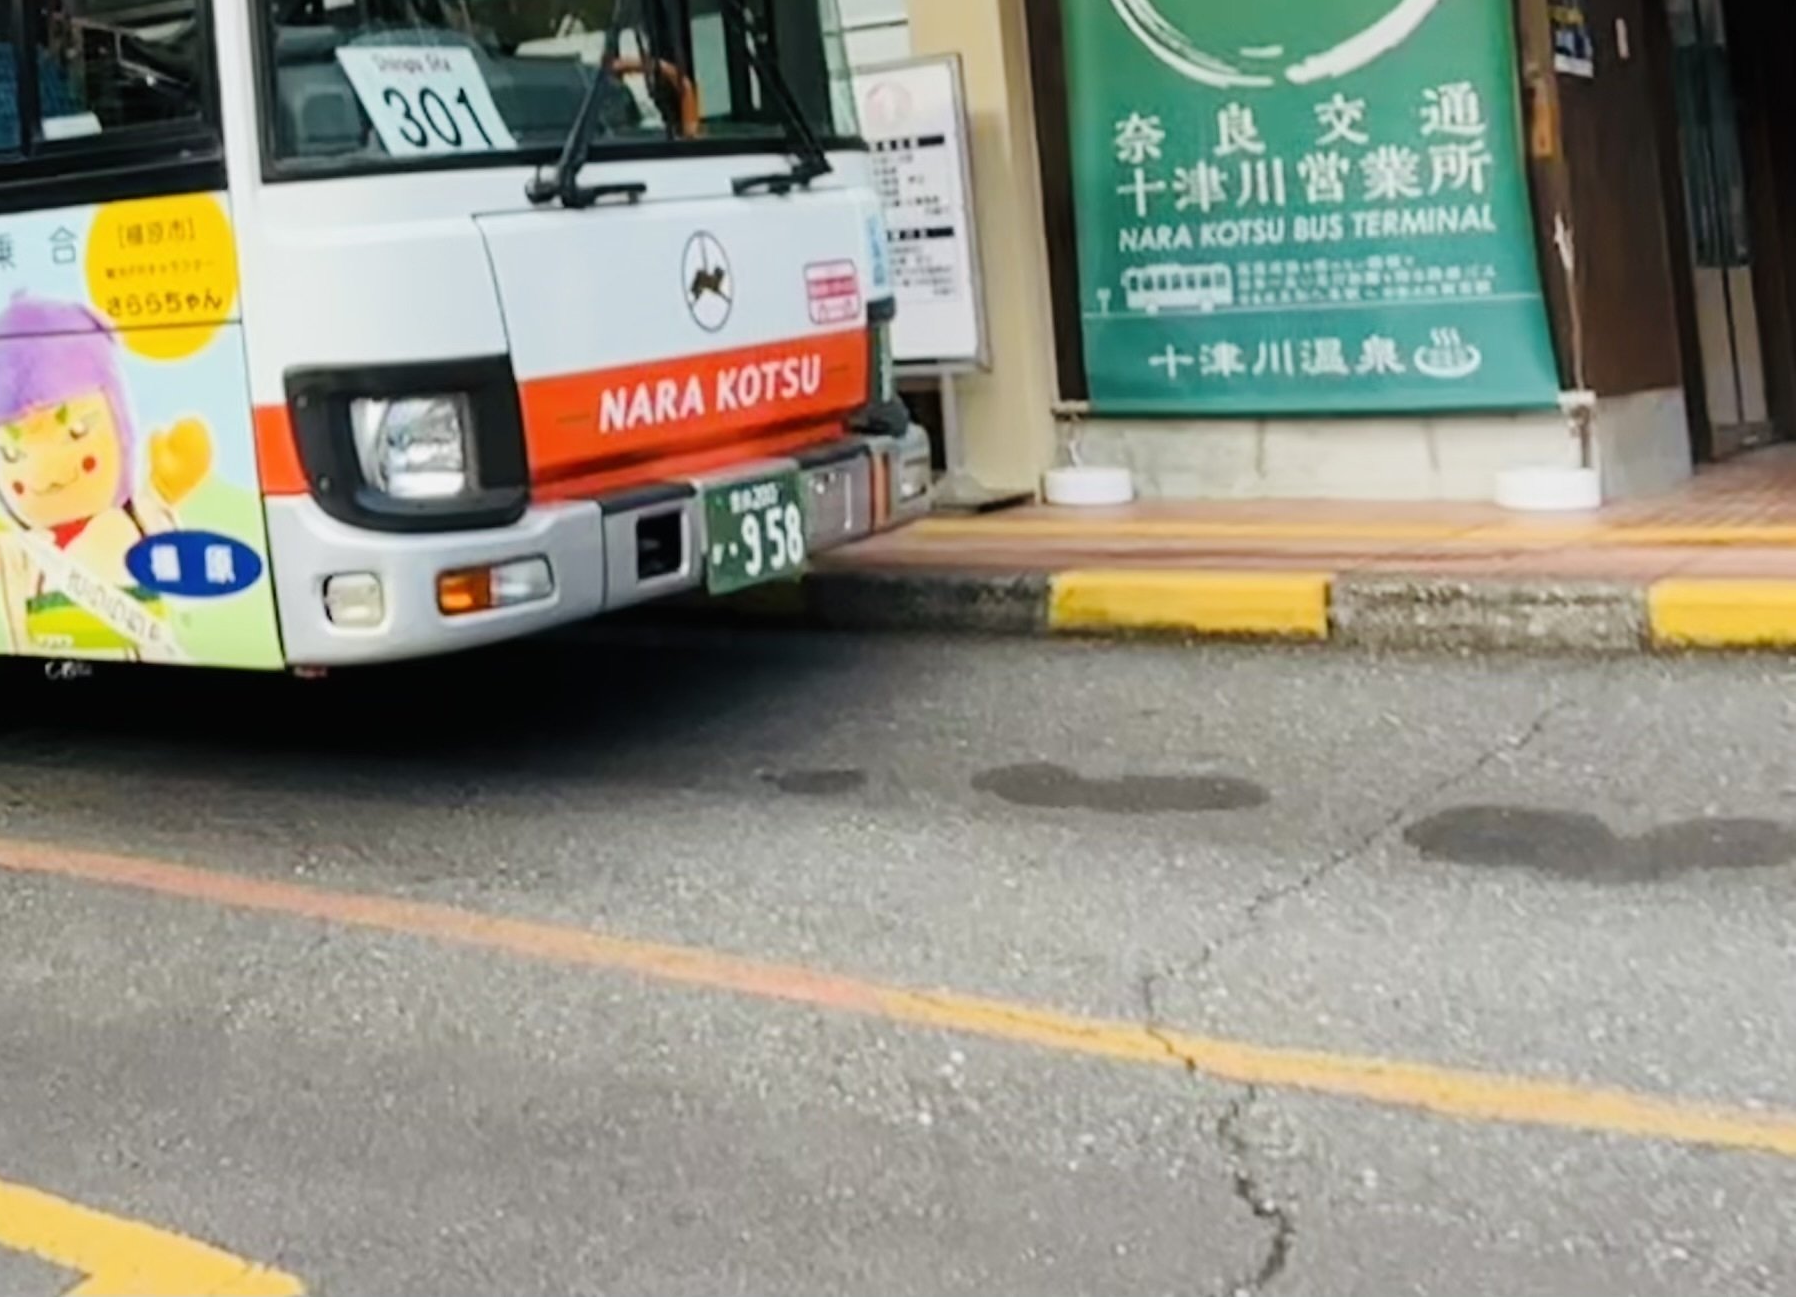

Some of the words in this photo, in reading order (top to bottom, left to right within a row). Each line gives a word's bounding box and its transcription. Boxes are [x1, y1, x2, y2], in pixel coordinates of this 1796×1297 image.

[382, 86, 494, 148] 301
[1115, 81, 1487, 164] 奈良交通
[1116, 140, 1493, 217] 十津川営業所
[1119, 223, 1194, 252] NARA
[1200, 217, 1285, 247] KOTSU
[1294, 213, 1344, 242] BUS
[1351, 204, 1497, 238] TERMINAL
[1147, 334, 1406, 379] 十津川温泉
[599, 373, 705, 434] NARA
[716, 353, 822, 413] KOTSU
